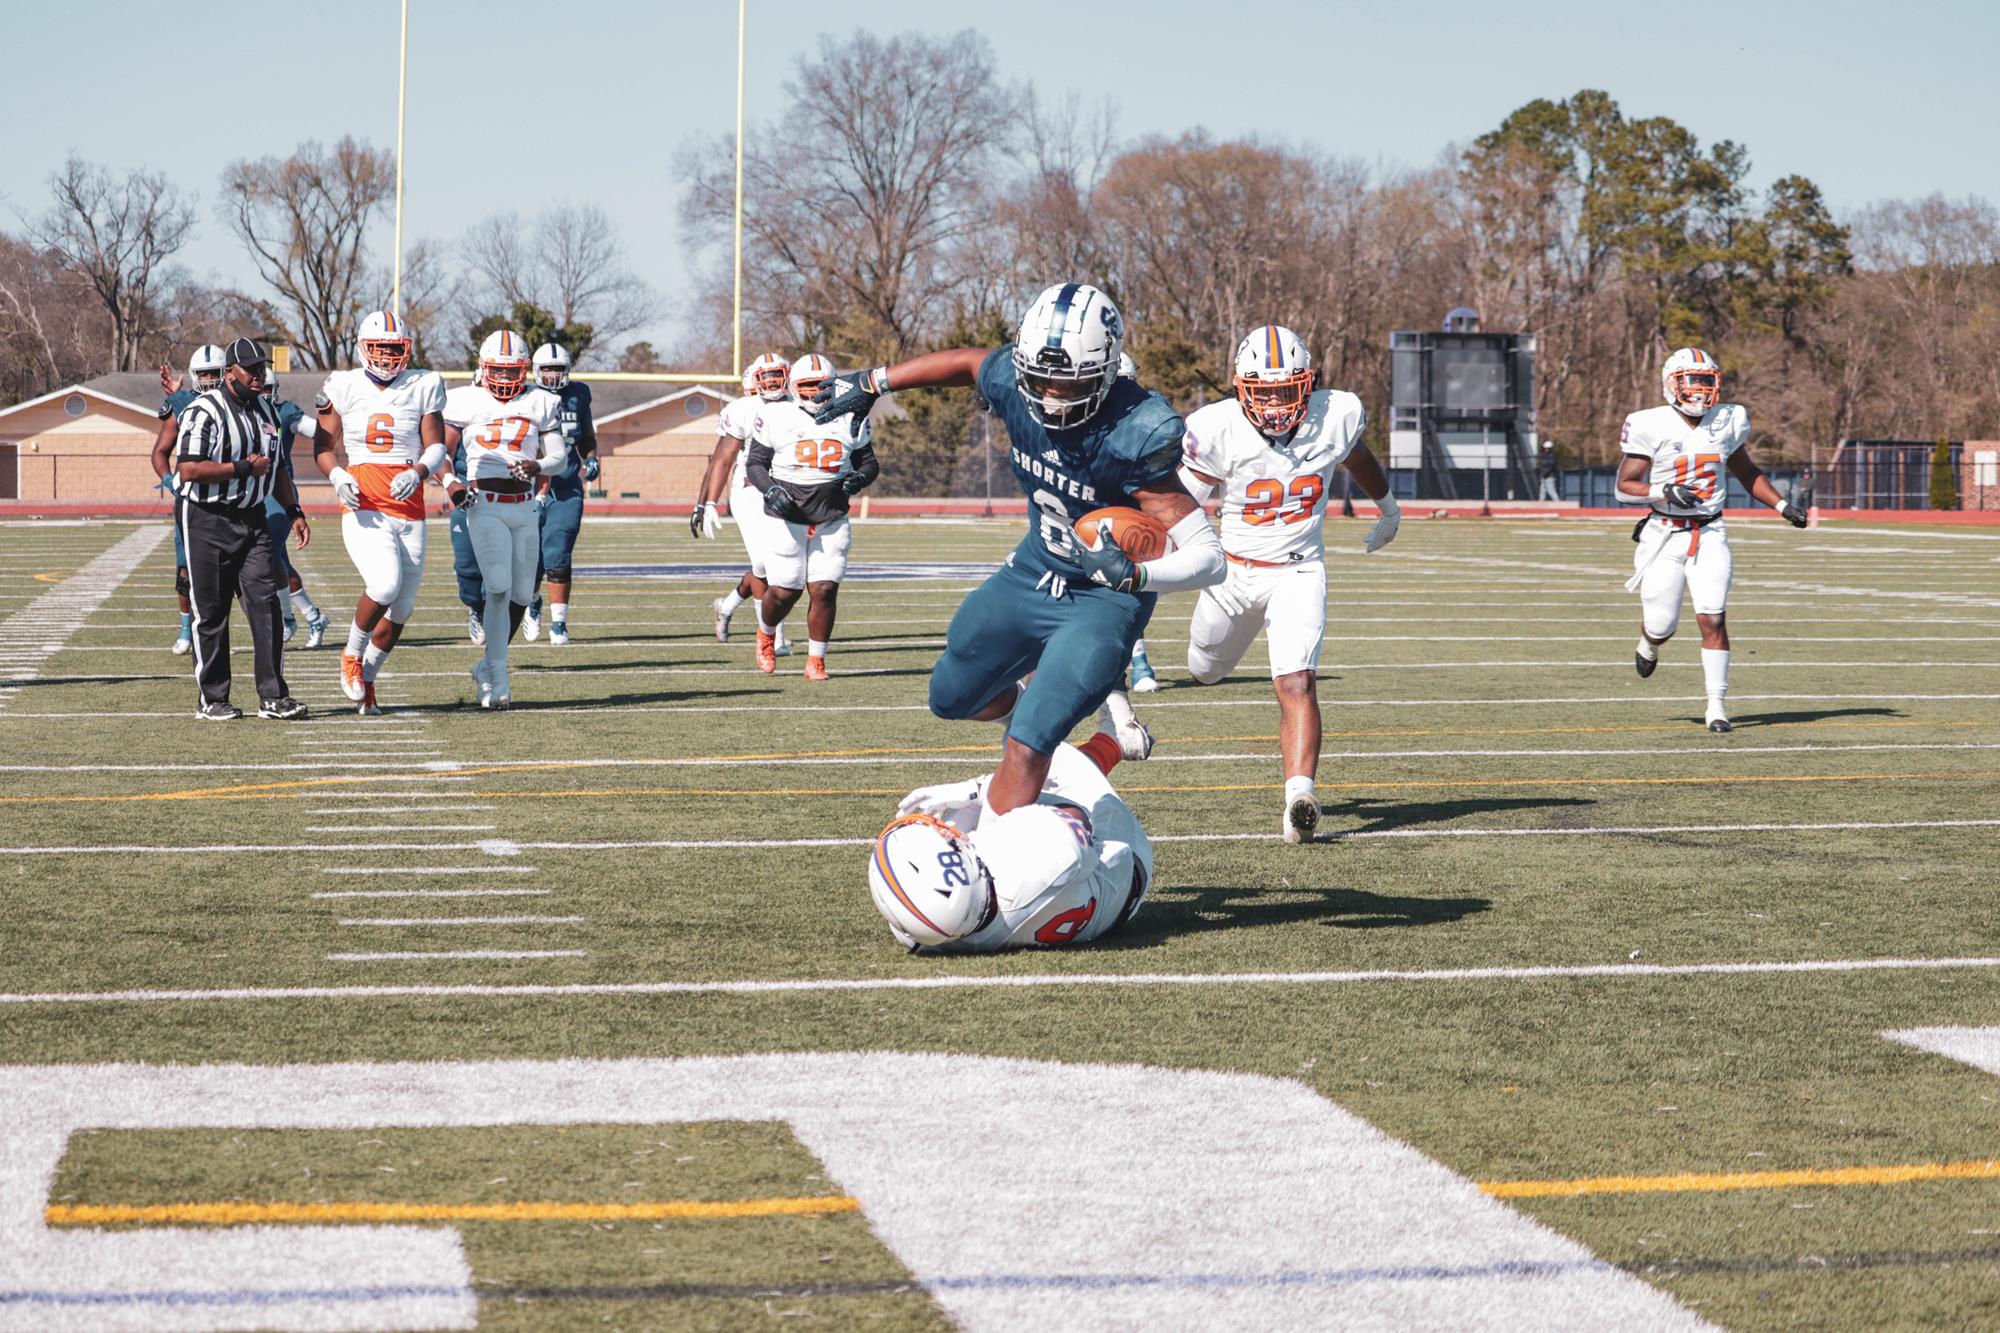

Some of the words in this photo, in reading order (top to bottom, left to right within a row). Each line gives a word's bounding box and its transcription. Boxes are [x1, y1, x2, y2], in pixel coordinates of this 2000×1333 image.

[366, 413, 395, 453] 6
[476, 416, 531, 452] 37
[795, 438, 843, 474] 92
[1012, 447, 1096, 502] SHORTER
[1673, 454, 1721, 500] 15
[1242, 474, 1324, 527] 23
[937, 850, 971, 888] 28
